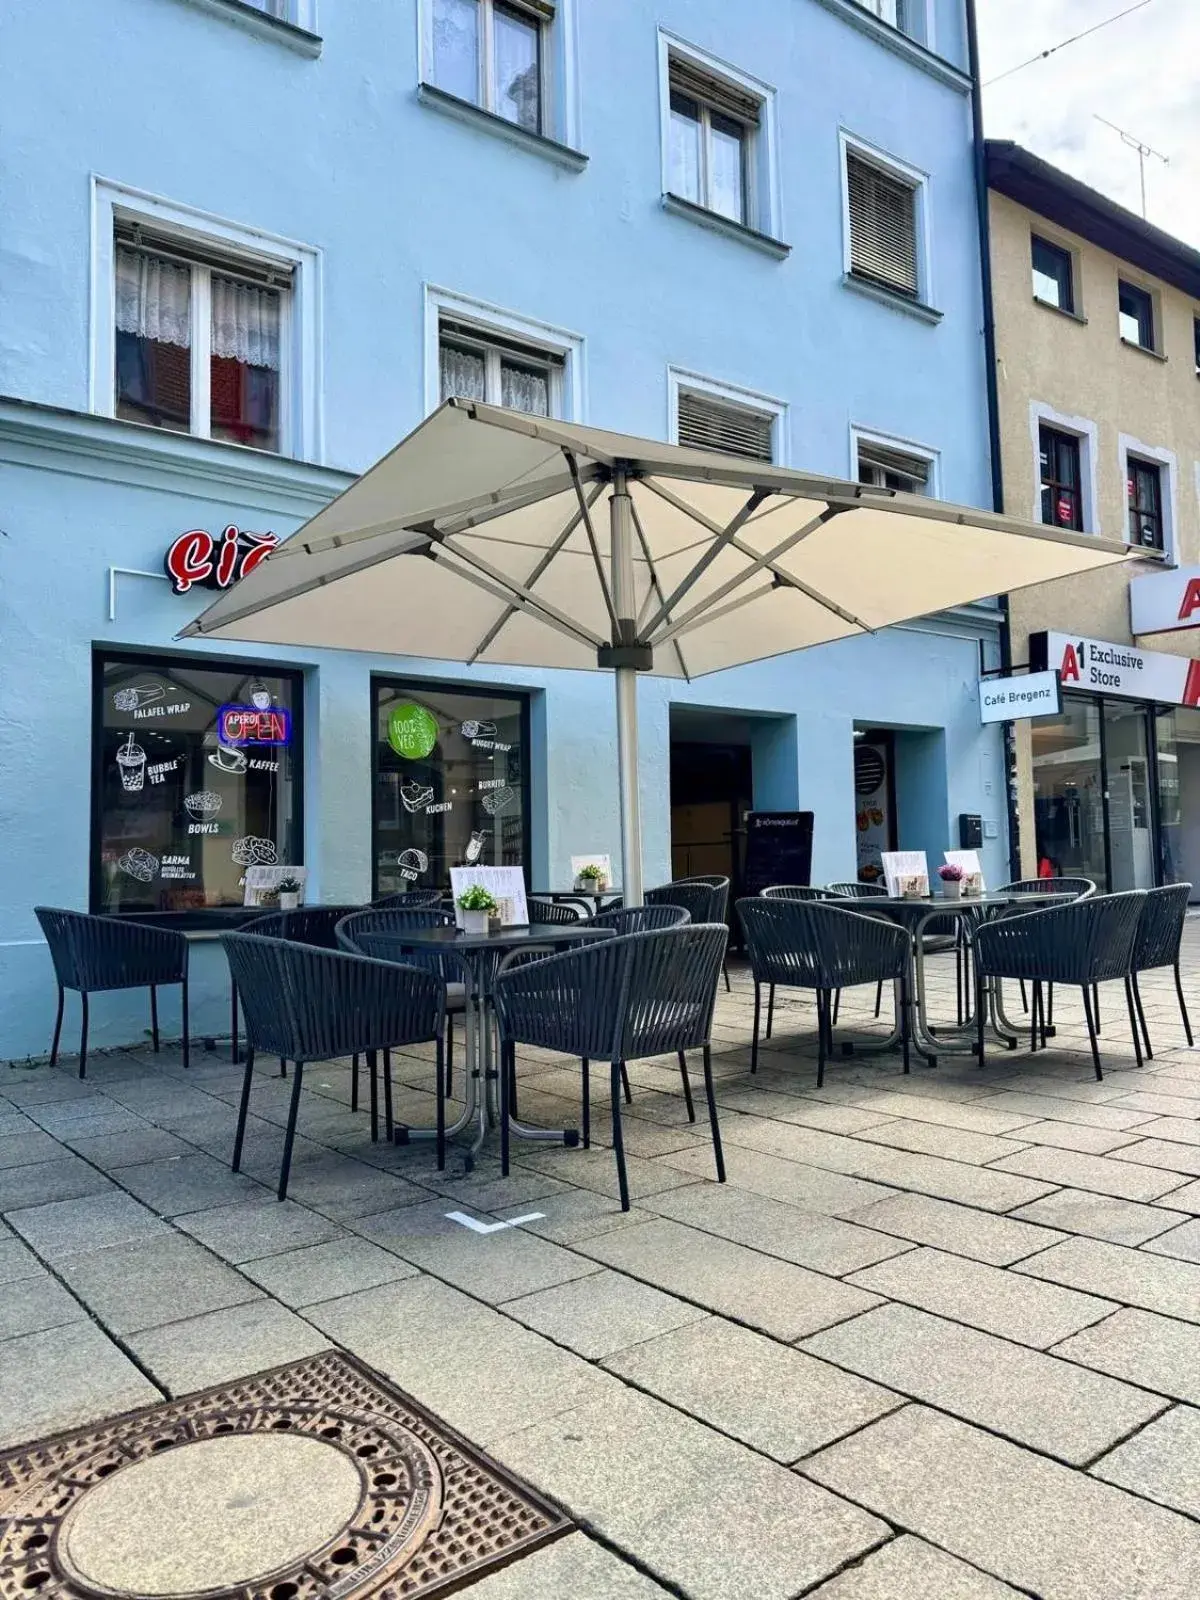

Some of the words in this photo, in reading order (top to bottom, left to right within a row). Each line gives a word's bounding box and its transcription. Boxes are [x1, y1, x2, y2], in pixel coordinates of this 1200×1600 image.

[1089, 644, 1143, 669] Exclusive
[1089, 667, 1121, 687] Store
[984, 692, 1006, 706] Café
[1008, 688, 1051, 703] Bregenz
[134, 706, 165, 719] FALAFEL
[166, 703, 190, 715] WRAP
[224, 711, 286, 741] OPEN
[472, 738, 494, 750] NUGGET
[495, 742, 512, 752] WRAP
[147, 760, 178, 776] BUBBLE
[248, 758, 280, 772] KAFFEE
[150, 773, 166, 785] TEA
[478, 779, 506, 790] BURRITO
[426, 801, 453, 815] KUCHEN
[188, 823, 219, 834] BOWLS
[161, 855, 190, 866] SARMA
[400, 868, 418, 881] TACO
